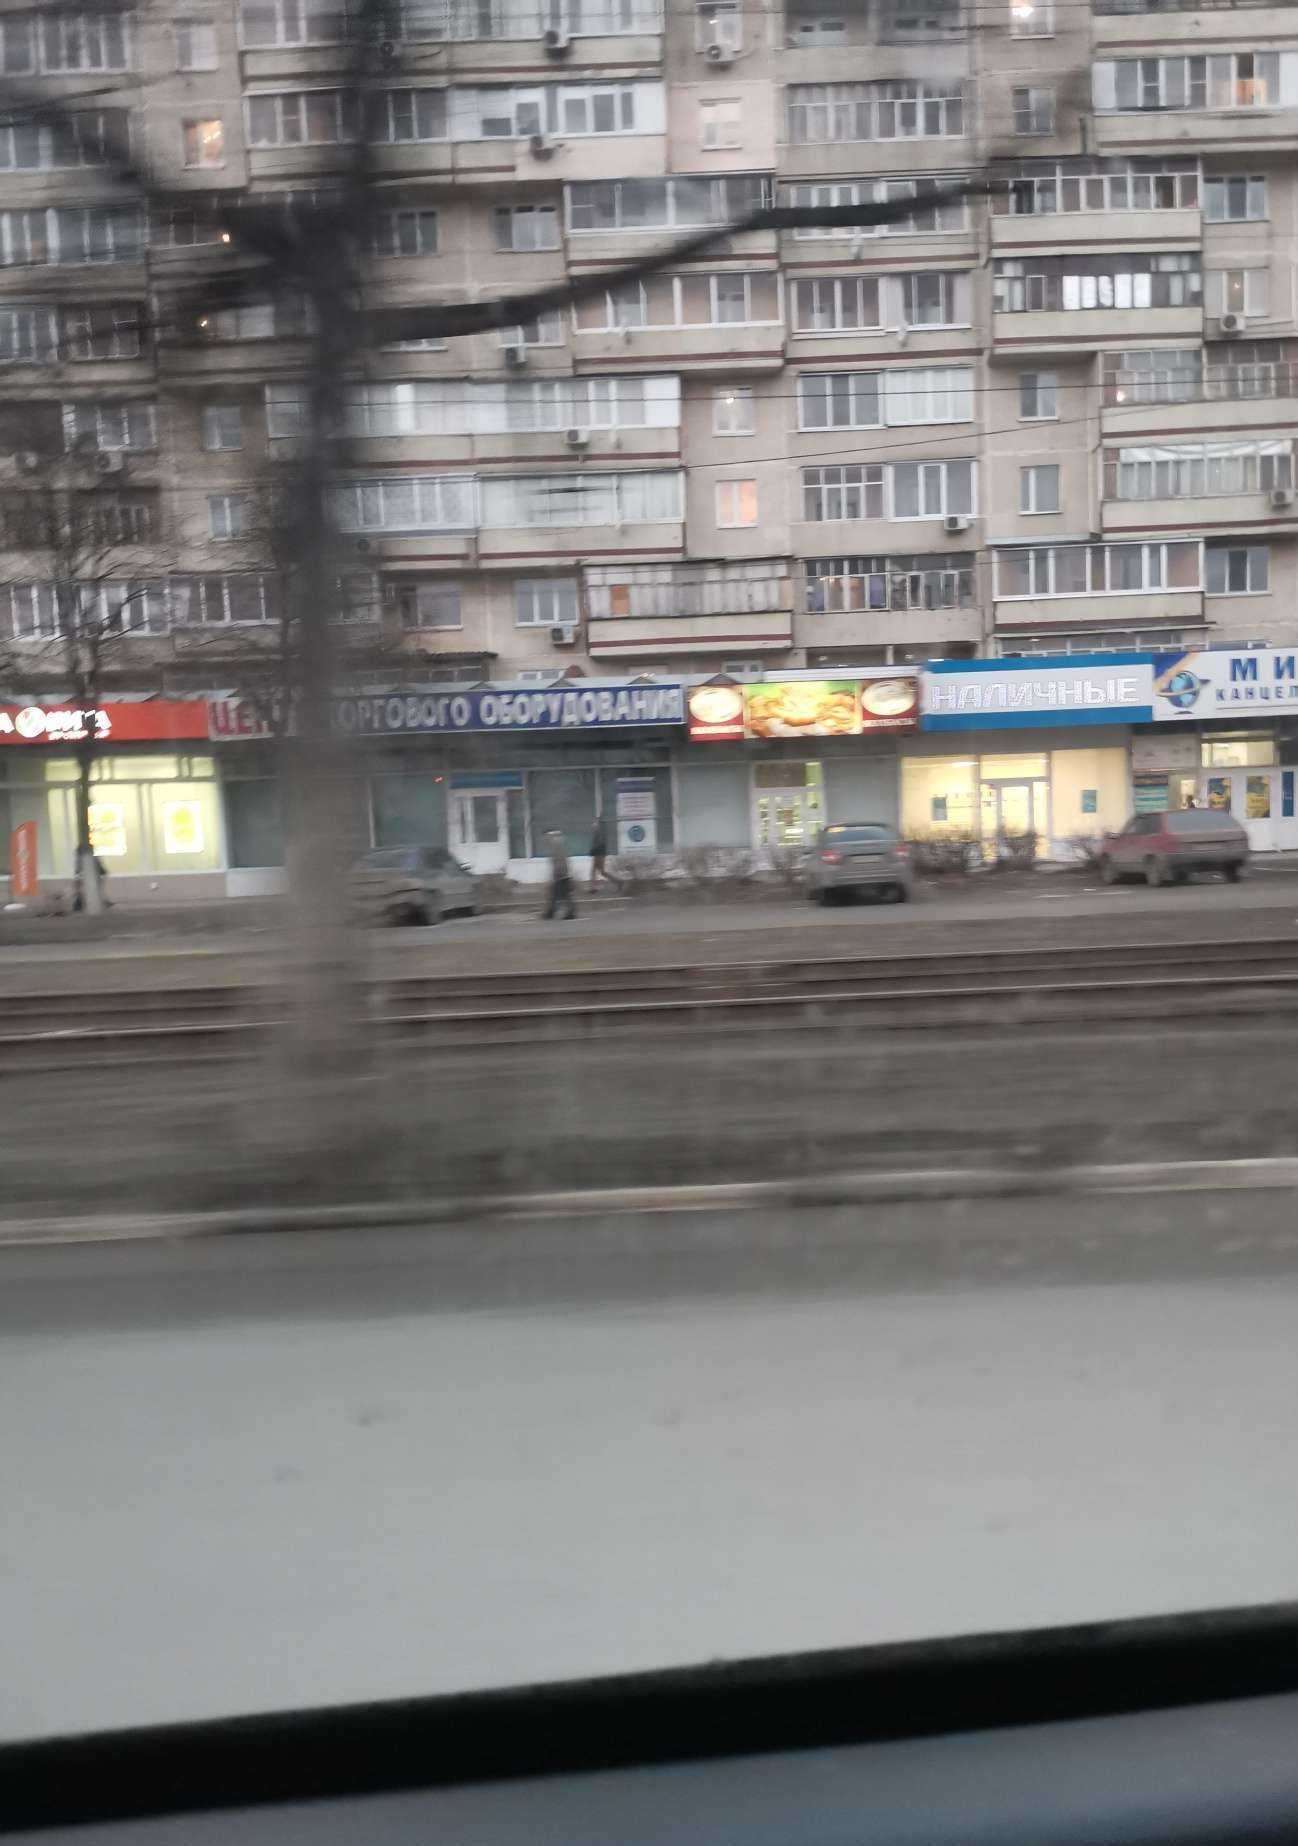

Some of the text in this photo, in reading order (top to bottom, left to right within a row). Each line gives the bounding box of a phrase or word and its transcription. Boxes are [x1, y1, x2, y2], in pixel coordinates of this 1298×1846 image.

[333, 695, 471, 729] ОРГОВОГО
[480, 689, 682, 727] ОБОРУДОВАНИЯ
[930, 677, 1140, 712] НАЛИЧНЫЕ
